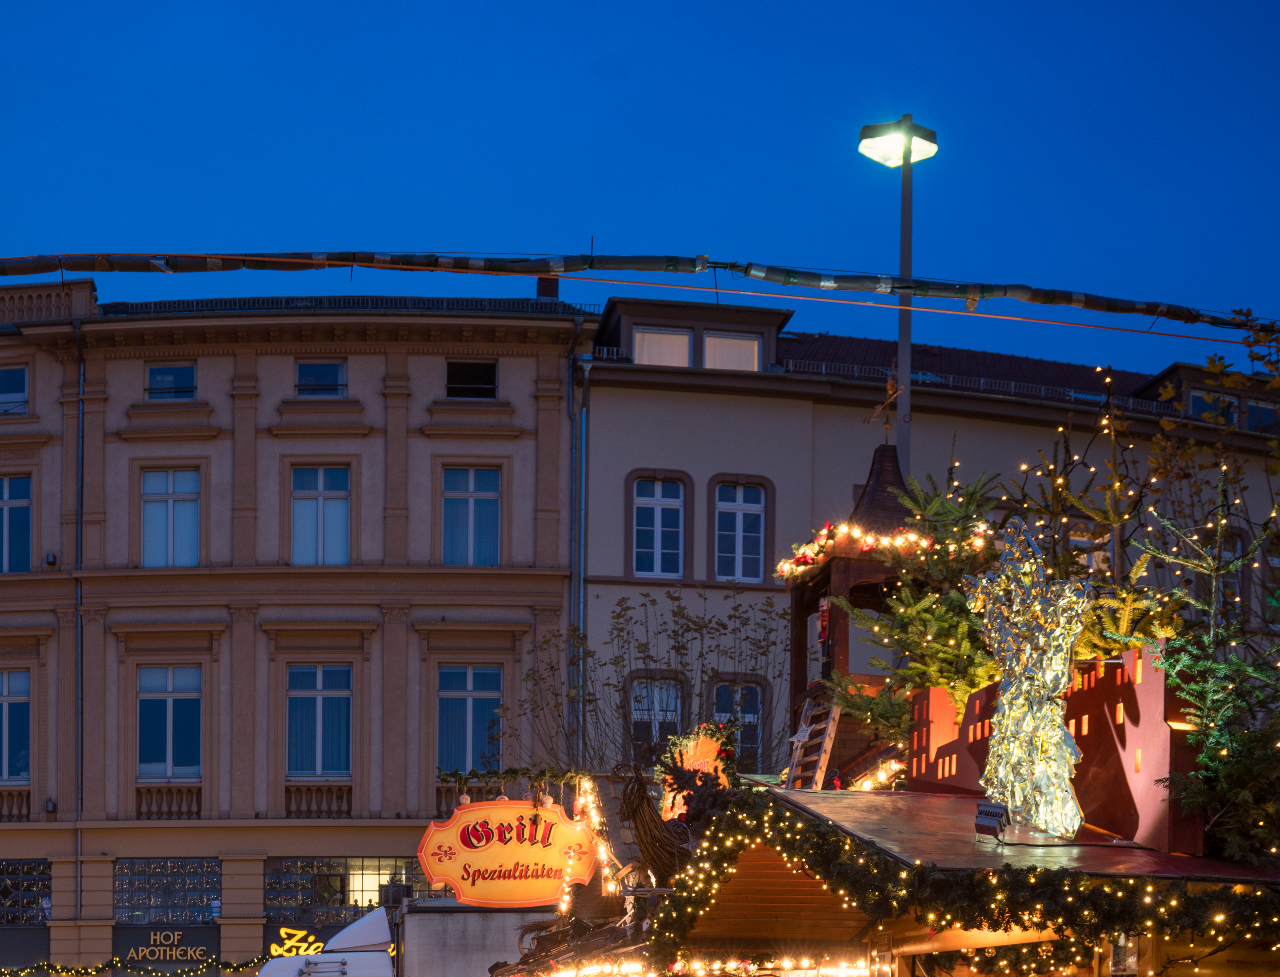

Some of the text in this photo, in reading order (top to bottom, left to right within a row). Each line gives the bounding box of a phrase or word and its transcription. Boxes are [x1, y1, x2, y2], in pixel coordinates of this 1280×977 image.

[459, 814, 557, 849] Grill
[460, 861, 564, 886] Spezialitäten
[150, 931, 182, 945] HOF
[127, 946, 207, 961] APOTHEKE
